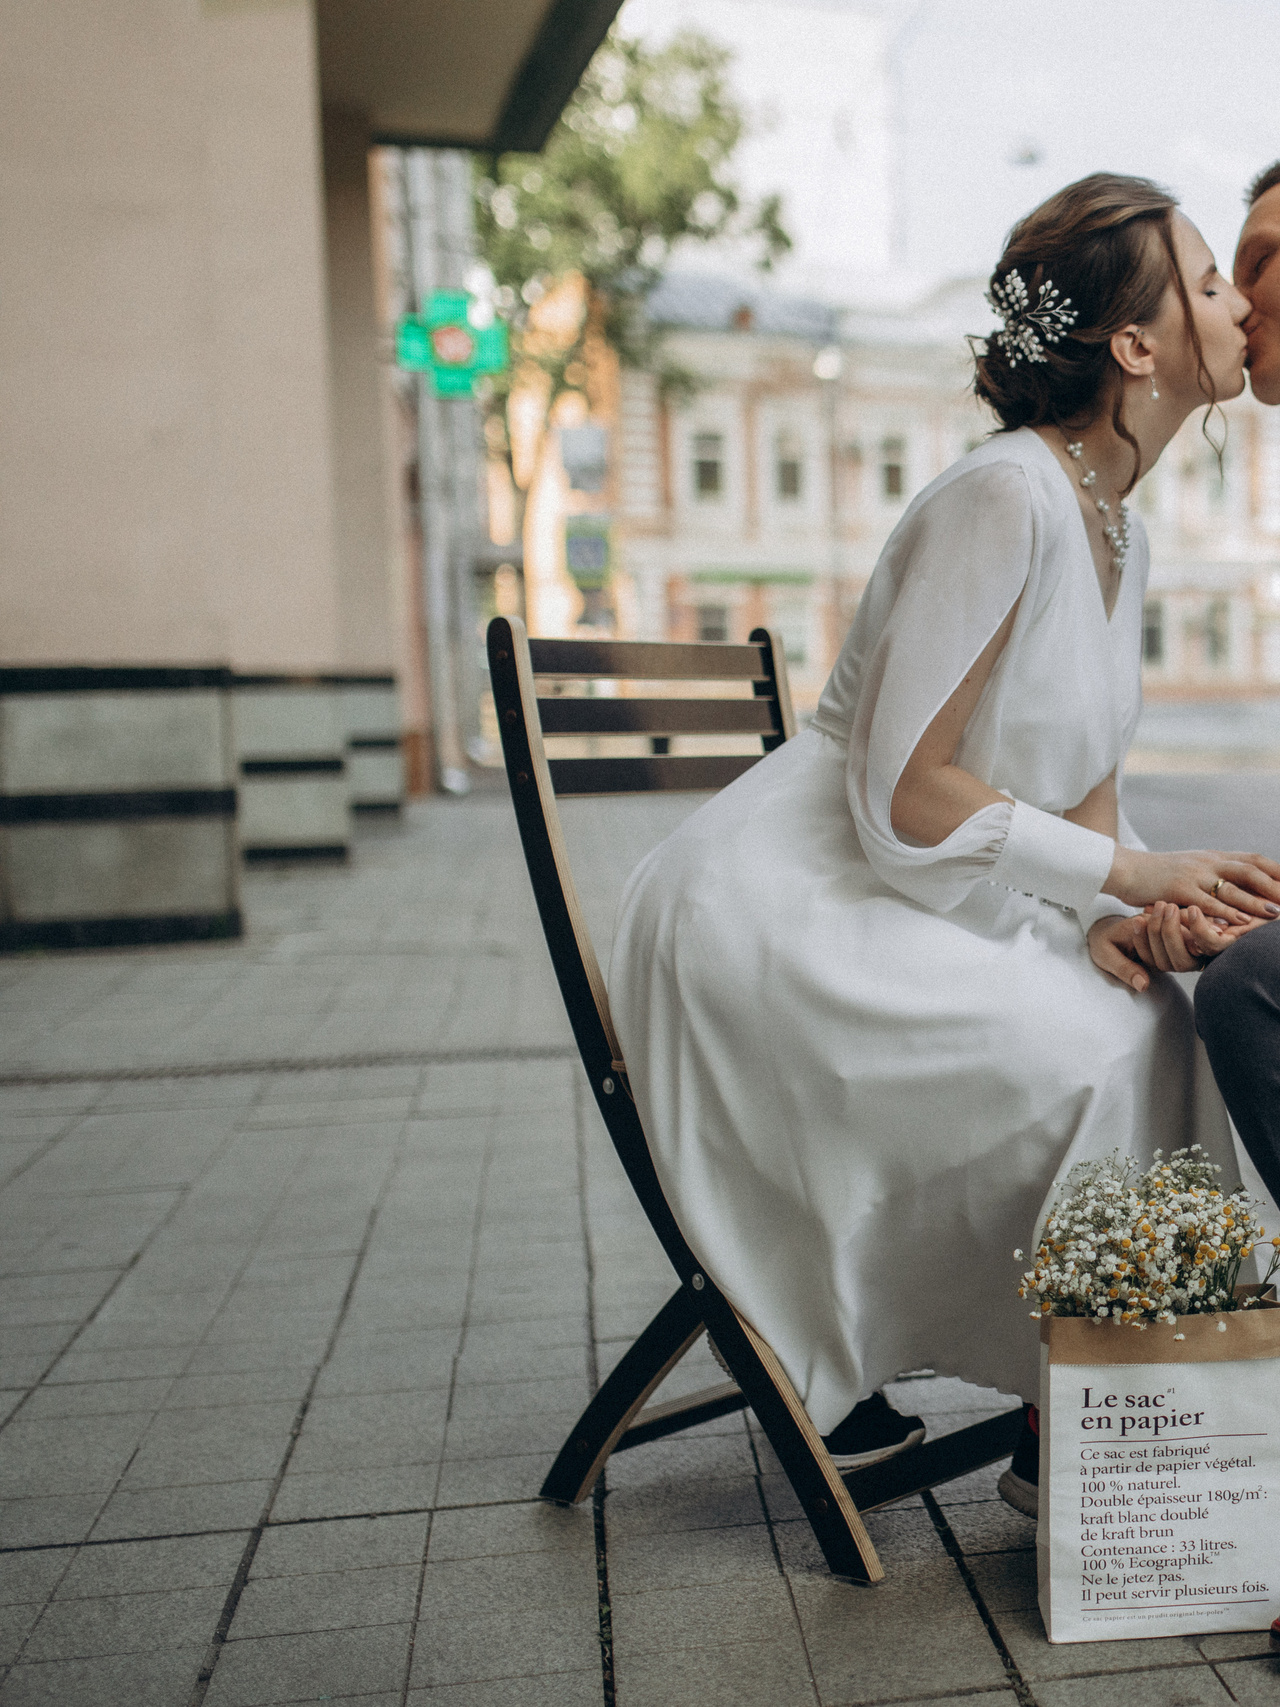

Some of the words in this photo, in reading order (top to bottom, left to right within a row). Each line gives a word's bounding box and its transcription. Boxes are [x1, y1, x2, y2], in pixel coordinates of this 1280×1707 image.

[1081, 1387, 1118, 1408] Le
[1124, 1393, 1166, 1408] sac
[1080, 1414, 1113, 1430] en
[1119, 1409, 1204, 1436] papier
[1080, 1448, 1100, 1460] Ce
[1103, 1449, 1125, 1459] sac
[1129, 1447, 1148, 1458] est
[1152, 1443, 1210, 1458] fabriqué
[1080, 1465, 1087, 1476] à
[1092, 1463, 1132, 1478] partir
[1135, 1461, 1152, 1473] de
[1156, 1460, 1201, 1475] papier
[1204, 1456, 1256, 1472] végétal.
[1081, 1481, 1105, 1493] 100
[1110, 1480, 1123, 1492] %
[1128, 1477, 1180, 1490] naturel.
[1080, 1493, 1134, 1508] Double
[1137, 1493, 1202, 1510] épaisseur
[1080, 1512, 1114, 1525] kraft
[1118, 1510, 1156, 1523] blanc
[1160, 1507, 1209, 1521] doublé
[1080, 1528, 1098, 1541] de
[1102, 1527, 1135, 1540] kraft
[1140, 1526, 1174, 1538] brun
[1081, 1543, 1168, 1558] Contenance
[1179, 1541, 1196, 1552] 33
[1200, 1539, 1237, 1550] litres.
[1082, 1560, 1107, 1571] 100
[1111, 1559, 1124, 1570] %
[1081, 1574, 1102, 1585] Ne
[1106, 1573, 1118, 1584] le
[1121, 1572, 1154, 1587] jetez
[1158, 1572, 1185, 1584] pas.
[1082, 1590, 1091, 1601] Il
[1096, 1590, 1127, 1604] peut
[1131, 1586, 1171, 1599] servir
[1175, 1584, 1238, 1601] plusieurs
[1242, 1580, 1269, 1593] fois.
